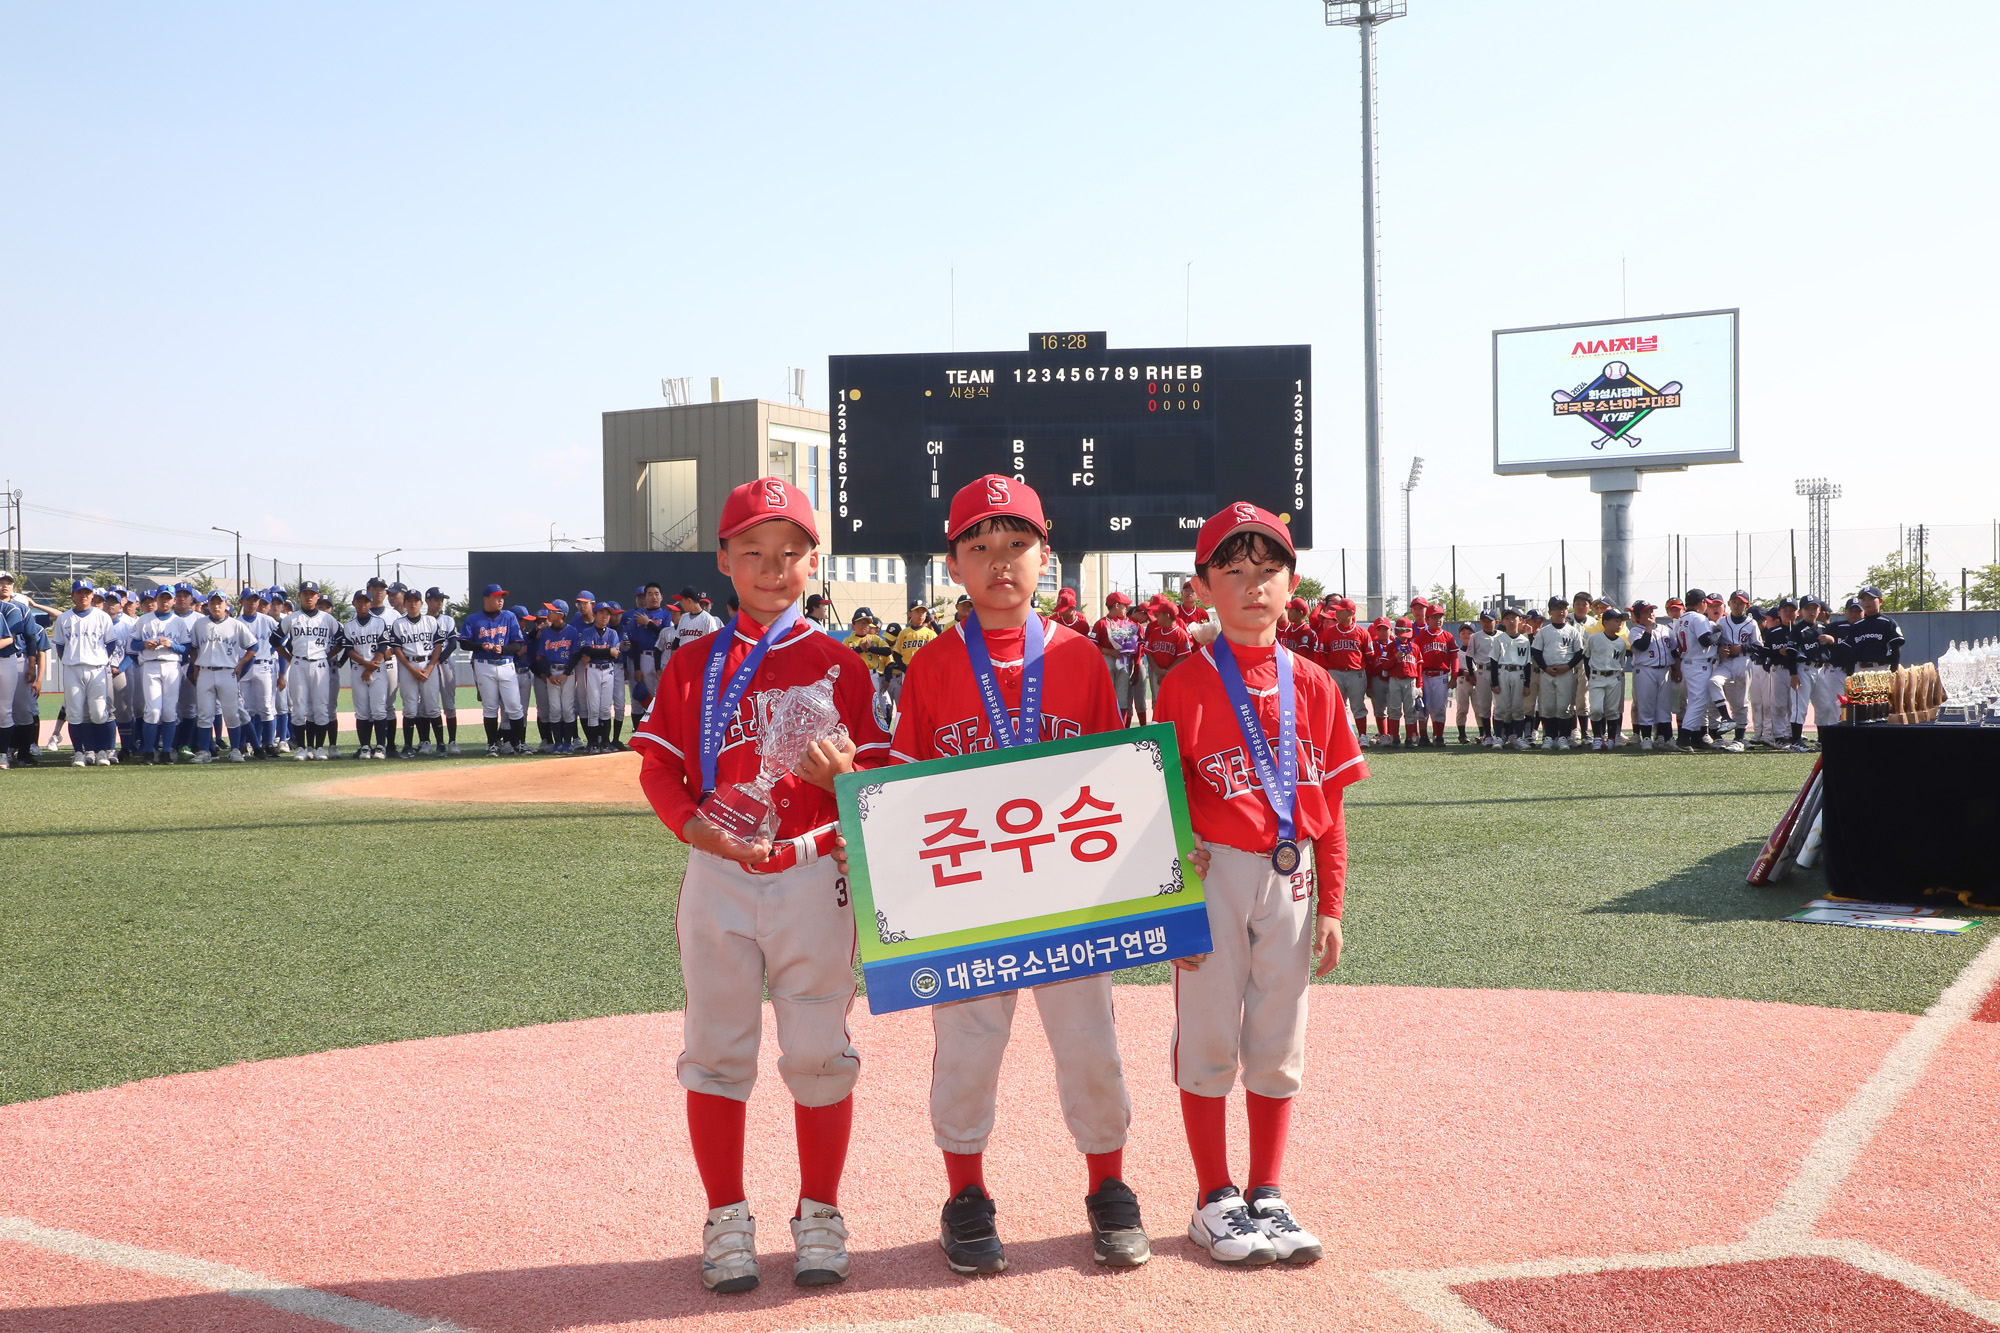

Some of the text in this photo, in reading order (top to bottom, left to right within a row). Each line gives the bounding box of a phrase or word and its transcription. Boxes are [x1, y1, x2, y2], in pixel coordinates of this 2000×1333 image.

[1040, 334, 1086, 350] 16:28
[1571, 335, 1658, 356] 시사저널
[946, 369, 994, 384] TEAM
[1014, 367, 1138, 382] 1 2 3 4 5 6 7 8 9
[950, 386, 989, 398] 시상식
[1570, 382, 1588, 396] 2024
[1588, 386, 1643, 400] 화성시장배
[1555, 394, 1680, 414] 전국유소년야구대회
[1600, 412, 1636, 423] KYBF
[927, 441, 942, 454] CH
[1013, 440, 1024, 453] B
[1083, 438, 1094, 452] H
[1294, 379, 1303, 510] 1 2 3 4 5 6 7 8 9
[838, 389, 848, 517] 1 2 3 4 5 6 7 8 9
[1014, 457, 1024, 470] S
[1083, 456, 1093, 468] E
[1072, 472, 1094, 486] FC
[765, 481, 787, 508] S
[987, 478, 1010, 505] S
[1235, 504, 1259, 522] S
[853, 520, 862, 531] P
[1110, 517, 1132, 531] SP
[293, 627, 328, 638] DAECHI
[401, 632, 433, 644] DAECHI
[680, 628, 702, 637] Giants
[315, 638, 325, 647] 44
[1562, 638, 1571, 646] W
[227, 648, 232, 656] 5
[1517, 647, 1526, 656] W
[1272, 790, 1284, 806] 2024
[918, 785, 1122, 888] 준우승
[835, 877, 848, 907] 3
[946, 926, 1168, 991] 대한유소년야구연맹
